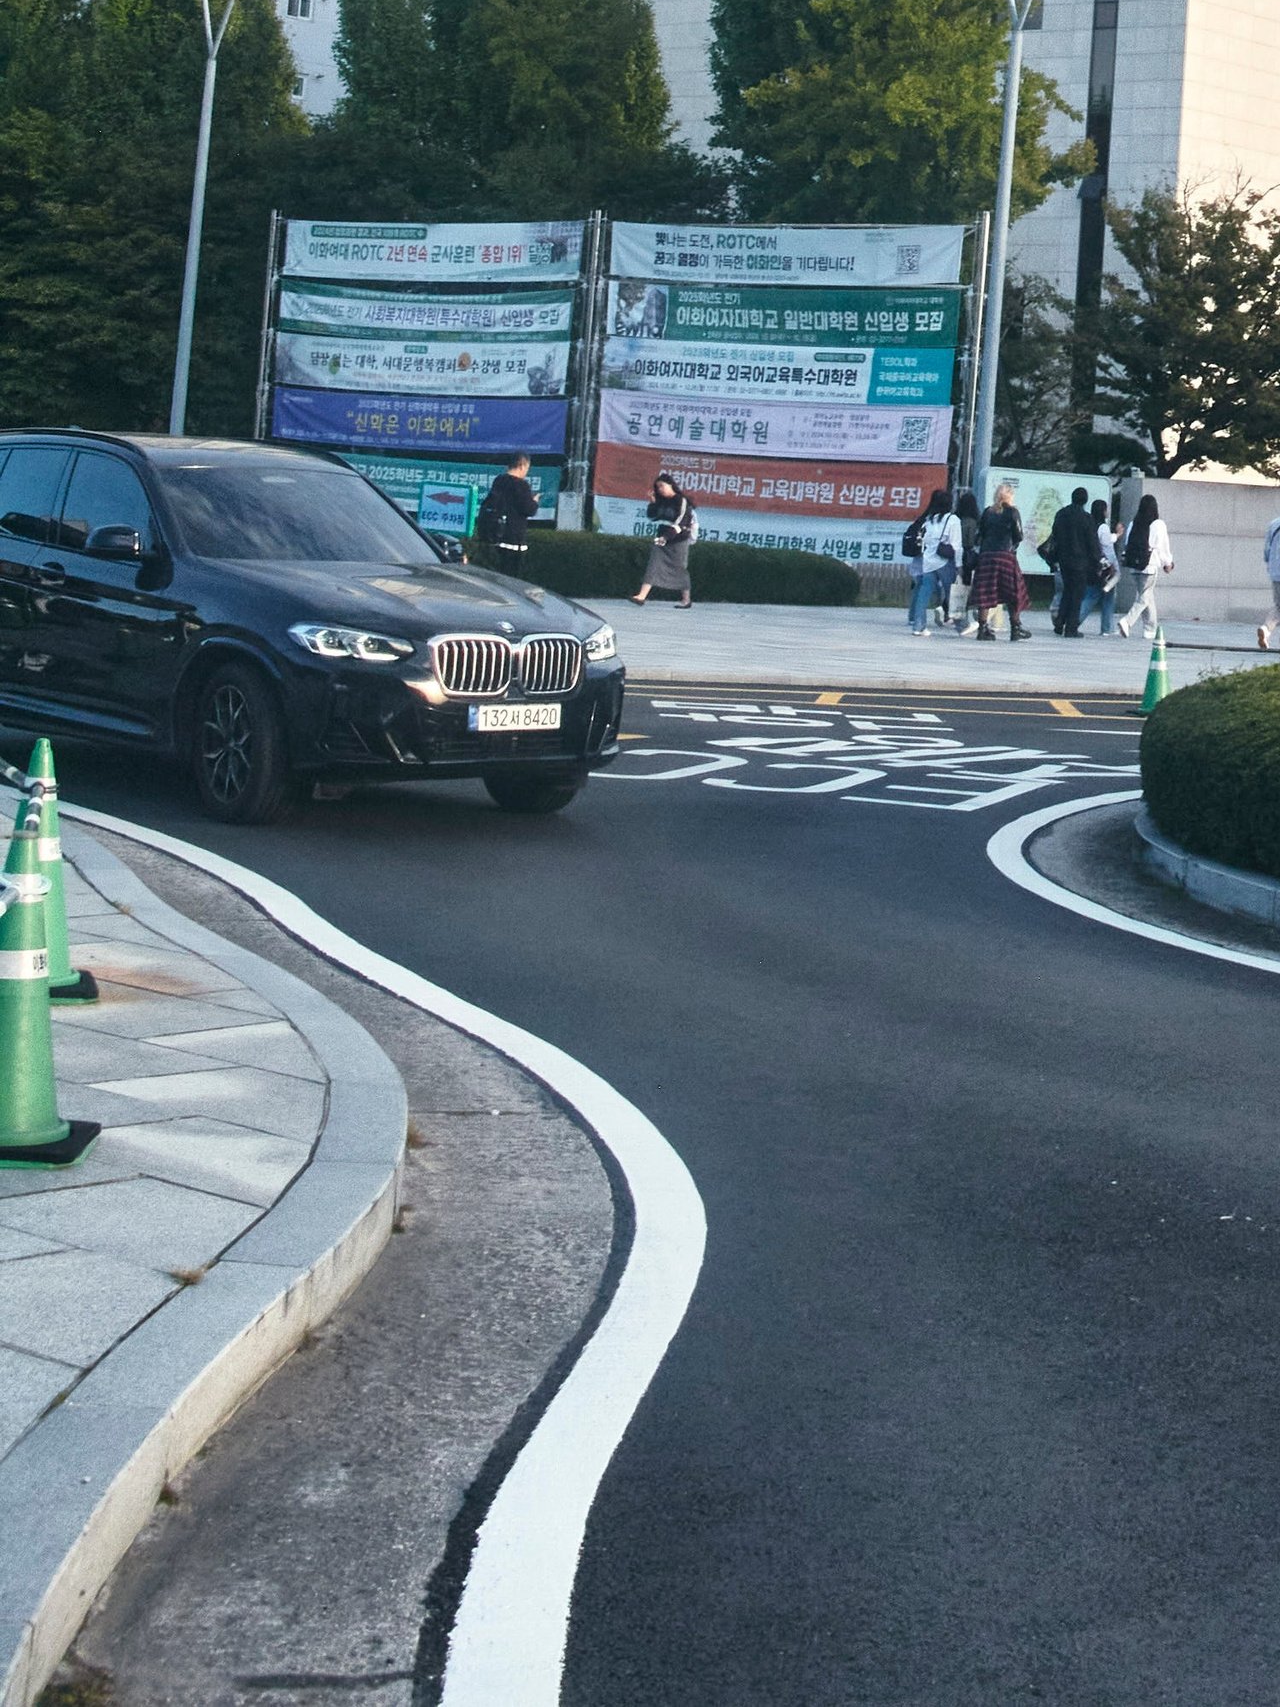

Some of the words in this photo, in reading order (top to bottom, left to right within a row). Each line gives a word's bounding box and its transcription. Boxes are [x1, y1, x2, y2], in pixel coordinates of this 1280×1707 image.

[656, 232, 687, 248] 빛나는
[689, 234, 714, 250] 도전,
[717, 234, 777, 250] ROTC에서
[309, 242, 349, 260] 이화여대
[352, 244, 384, 261] ROTC
[387, 245, 404, 262] 2년
[407, 245, 427, 263] 연속
[431, 244, 475, 263] 군사훈련
[654, 251, 675, 265] 꿈과
[678, 252, 710, 268] 열정이
[713, 254, 744, 270] 가득한
[747, 254, 793, 271] 이화인을
[796, 256, 855, 272] 기다립니다!
[501, 309, 534, 327] 신입생
[539, 310, 559, 325] 모집
[676, 306, 778, 329] 이화여자대학교
[784, 310, 858, 332] 일반대학원
[864, 311, 909, 332] 신입생
[914, 311, 944, 332] 모집
[505, 359, 527, 374] 모집
[635, 359, 721, 380] 이화여자대학교
[726, 364, 858, 386] 외국어교육특수대학원
[369, 466, 424, 482] 2025학년도
[760, 478, 835, 504] 교육대학원
[839, 484, 886, 507] 신입생
[889, 486, 922, 509] 모집
[422, 511, 438, 521] ECC
[822, 538, 862, 559] 신입생
[867, 543, 895, 561] 모집
